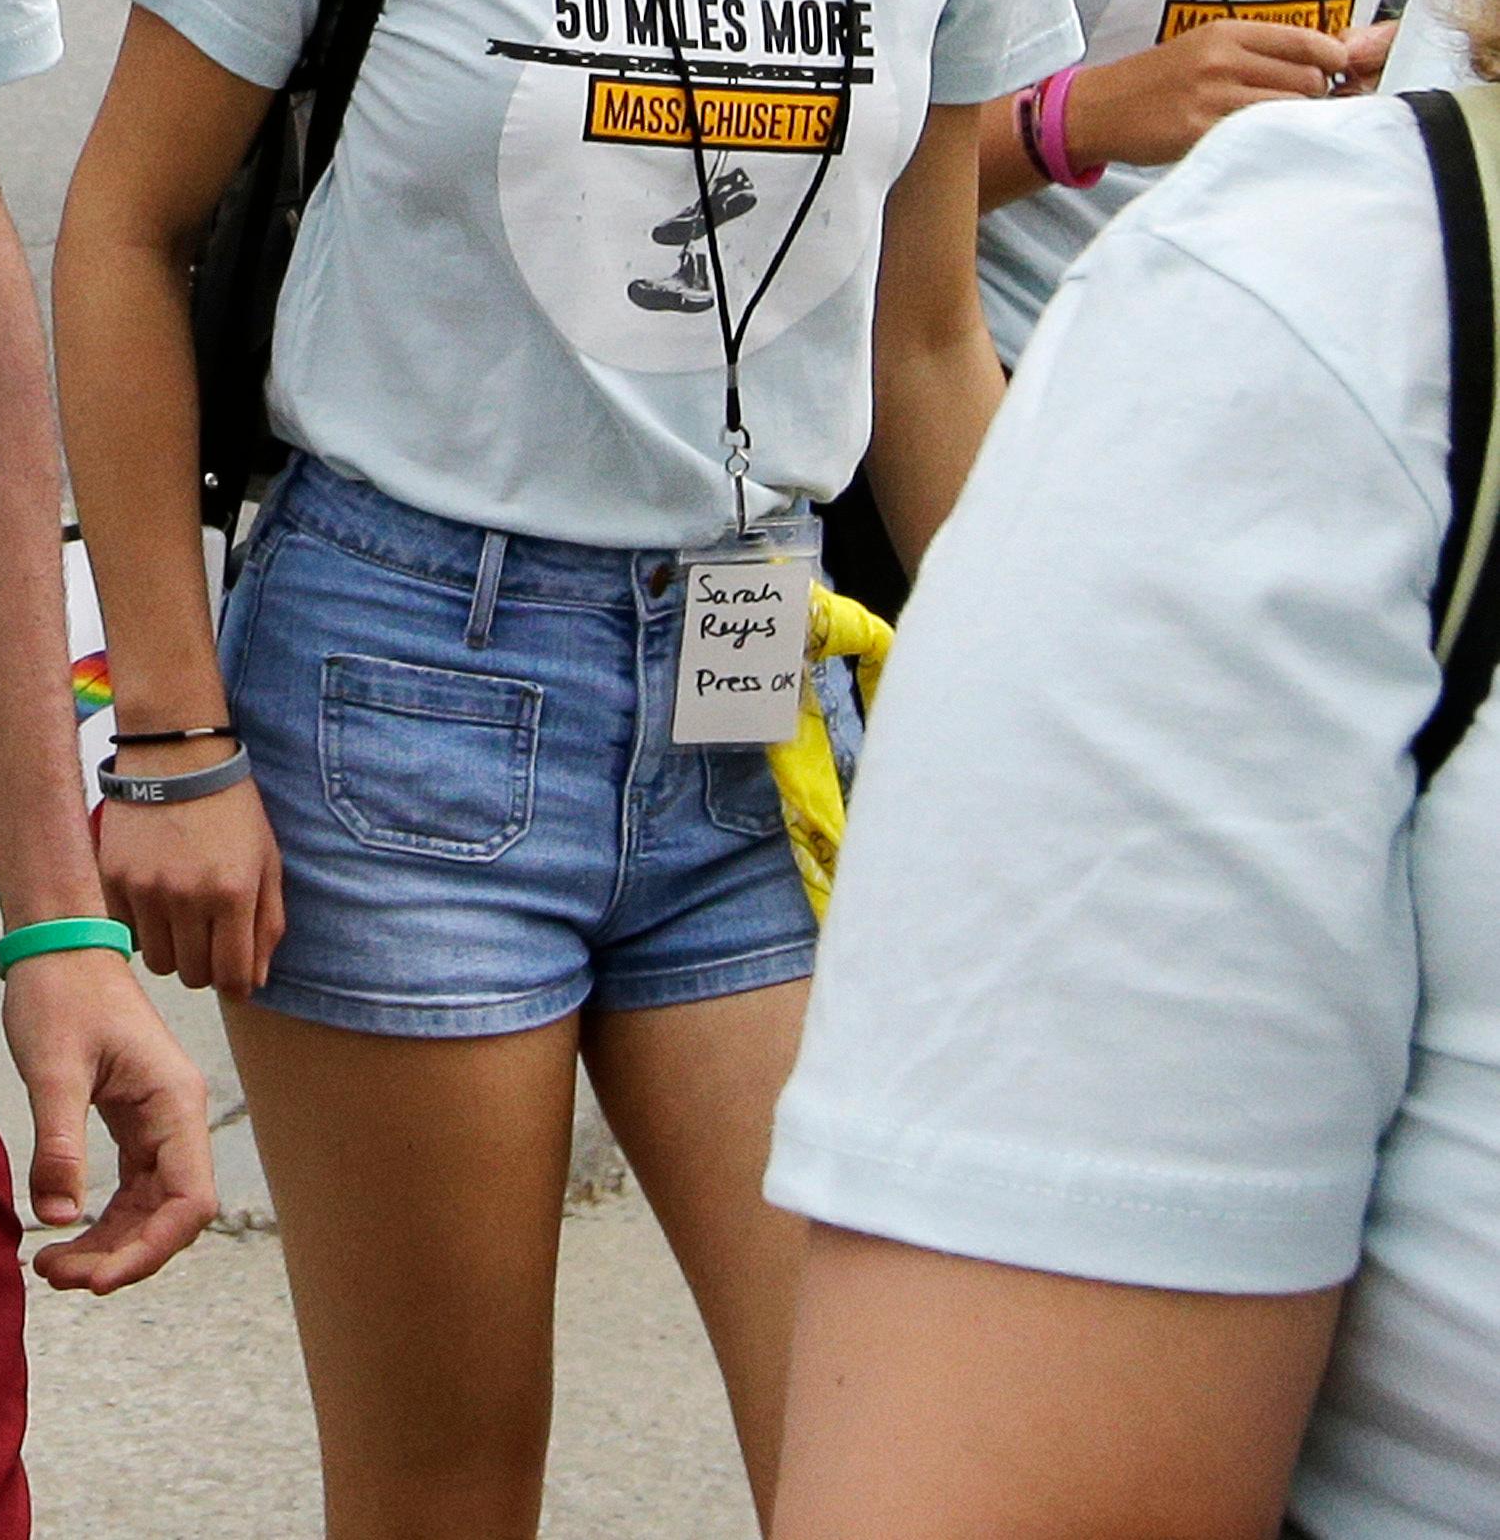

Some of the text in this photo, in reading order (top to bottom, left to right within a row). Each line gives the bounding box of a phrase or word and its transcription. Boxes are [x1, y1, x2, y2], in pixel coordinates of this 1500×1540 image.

[696, 573, 782, 605] Sarah
[695, 668, 797, 696] Press OK
[130, 783, 165, 801] ME
